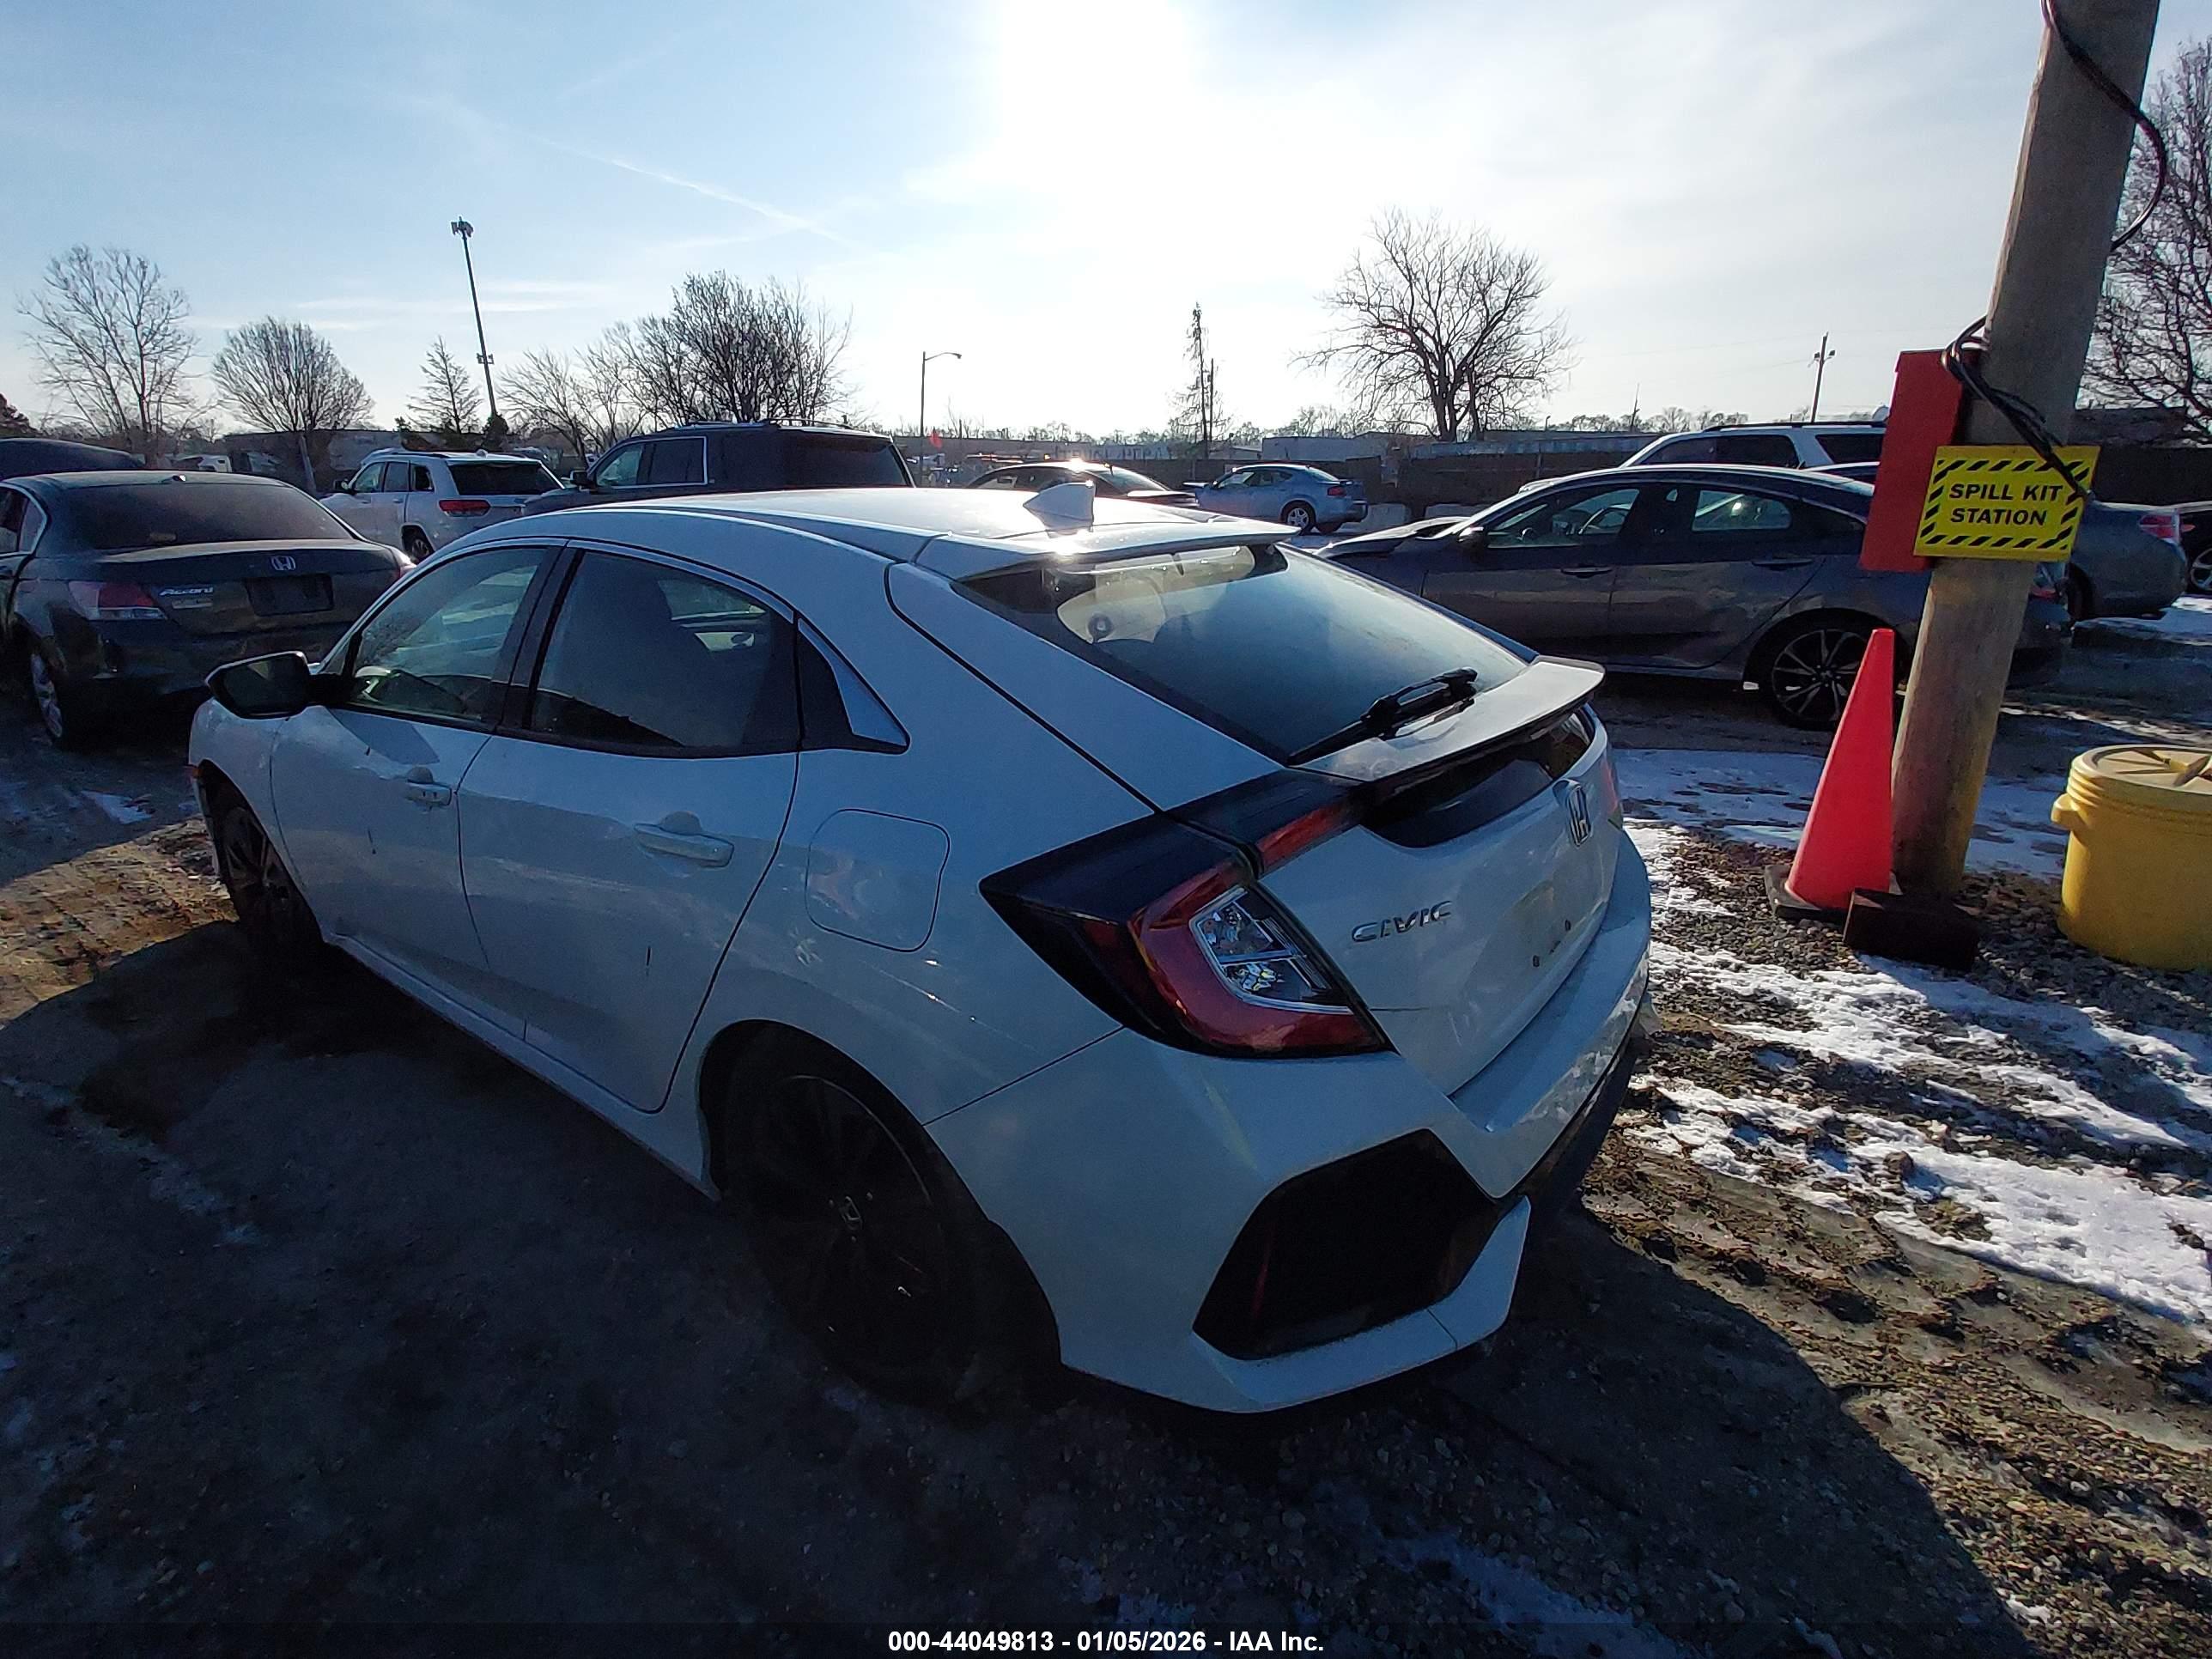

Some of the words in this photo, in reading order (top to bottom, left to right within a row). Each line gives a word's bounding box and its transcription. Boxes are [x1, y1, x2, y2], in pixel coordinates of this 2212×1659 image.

[1949, 483, 2014, 501] SPILL
[2022, 485, 2063, 501] KIT
[1950, 507, 2047, 526] STATION
[1352, 900, 1452, 943] CIVIC
